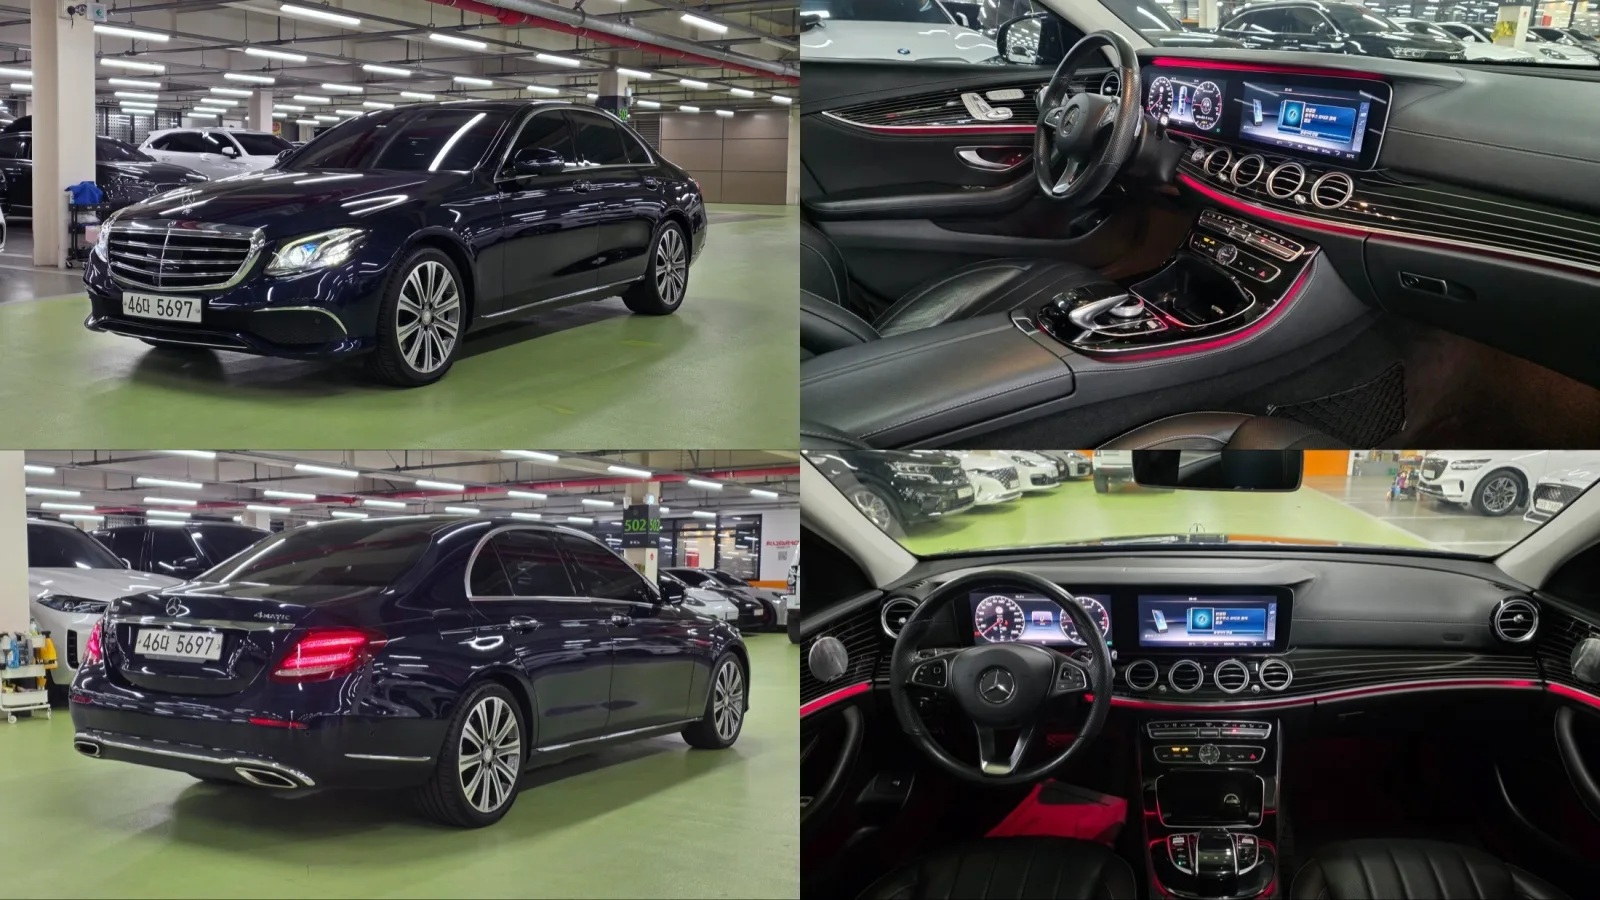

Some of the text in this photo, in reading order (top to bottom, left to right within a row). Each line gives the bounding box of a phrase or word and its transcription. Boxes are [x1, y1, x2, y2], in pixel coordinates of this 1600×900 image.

[128, 296, 193, 318] 46다 5697
[624, 518, 647, 532] 502
[649, 518, 660, 532] 502
[253, 611, 291, 620] 4MATIC
[142, 633, 214, 655] 46다 5697
